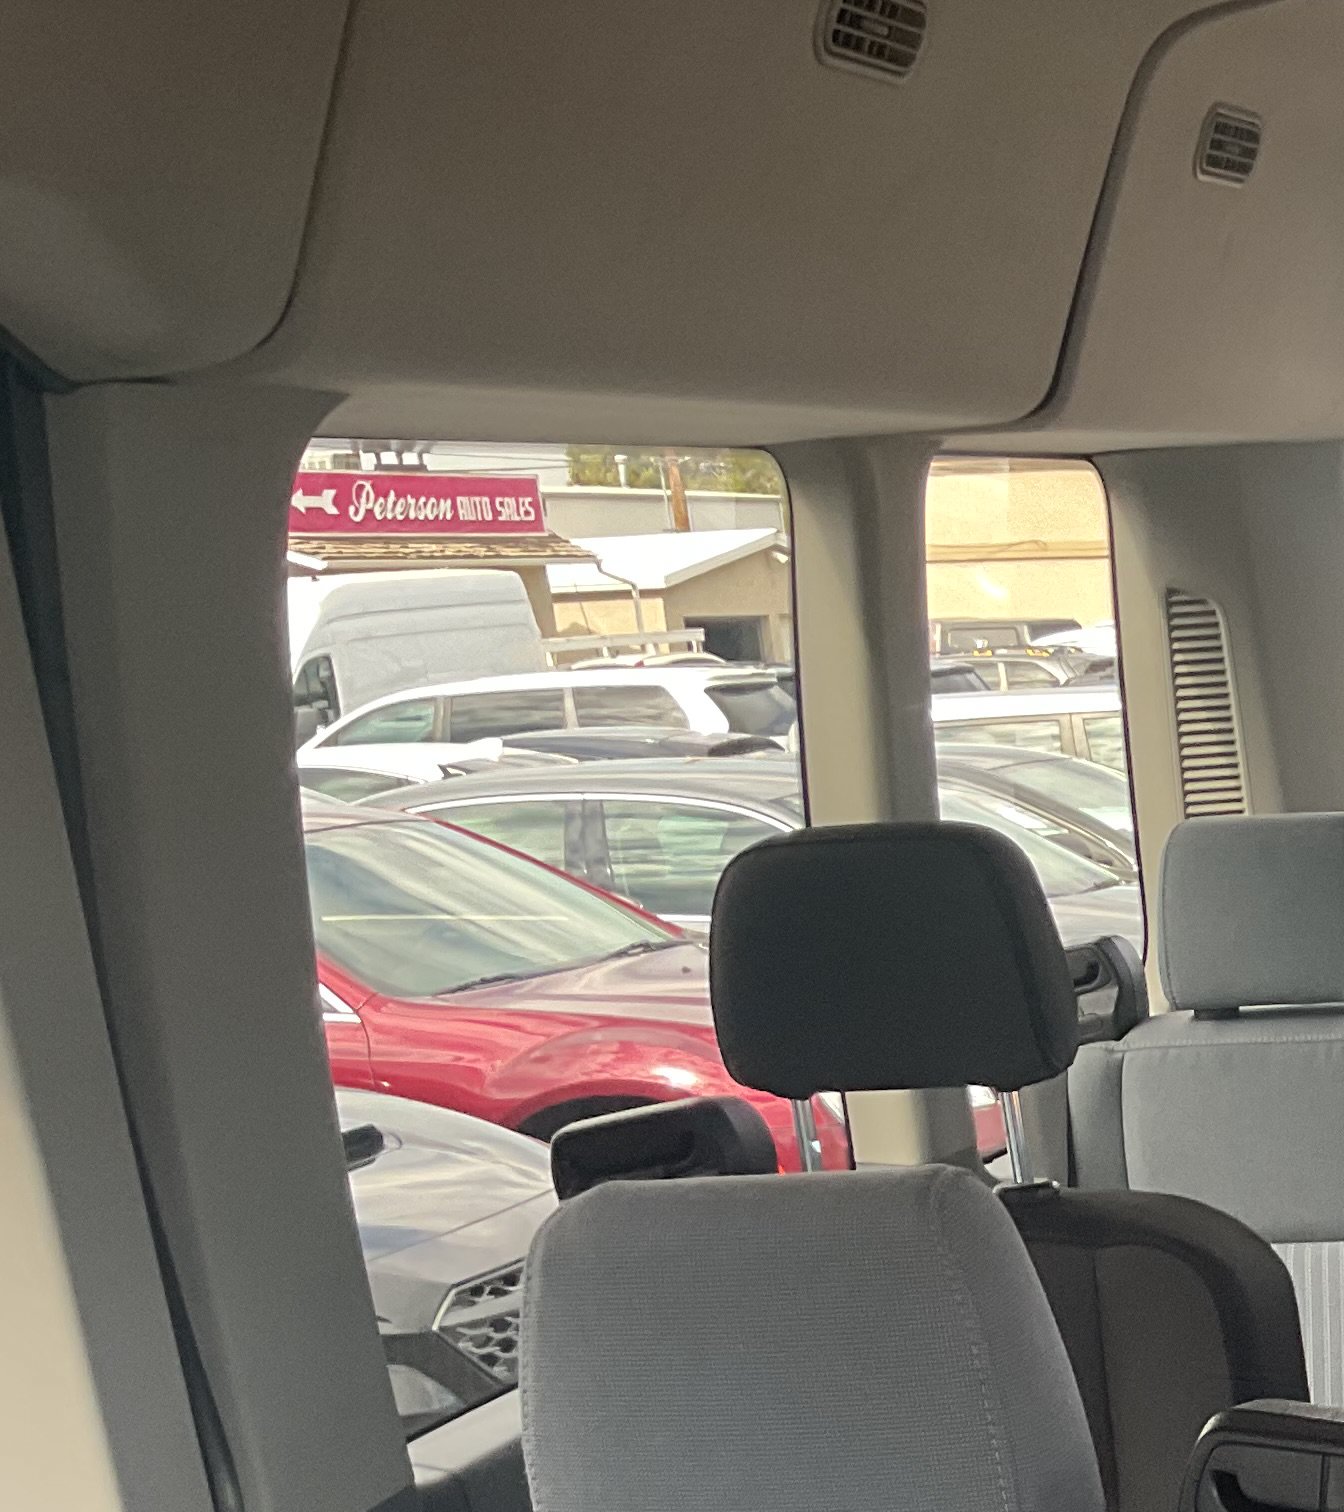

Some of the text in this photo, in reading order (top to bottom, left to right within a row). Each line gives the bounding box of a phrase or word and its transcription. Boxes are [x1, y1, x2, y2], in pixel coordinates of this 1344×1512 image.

[348, 479, 536, 523] Peterson AUTO SALES
